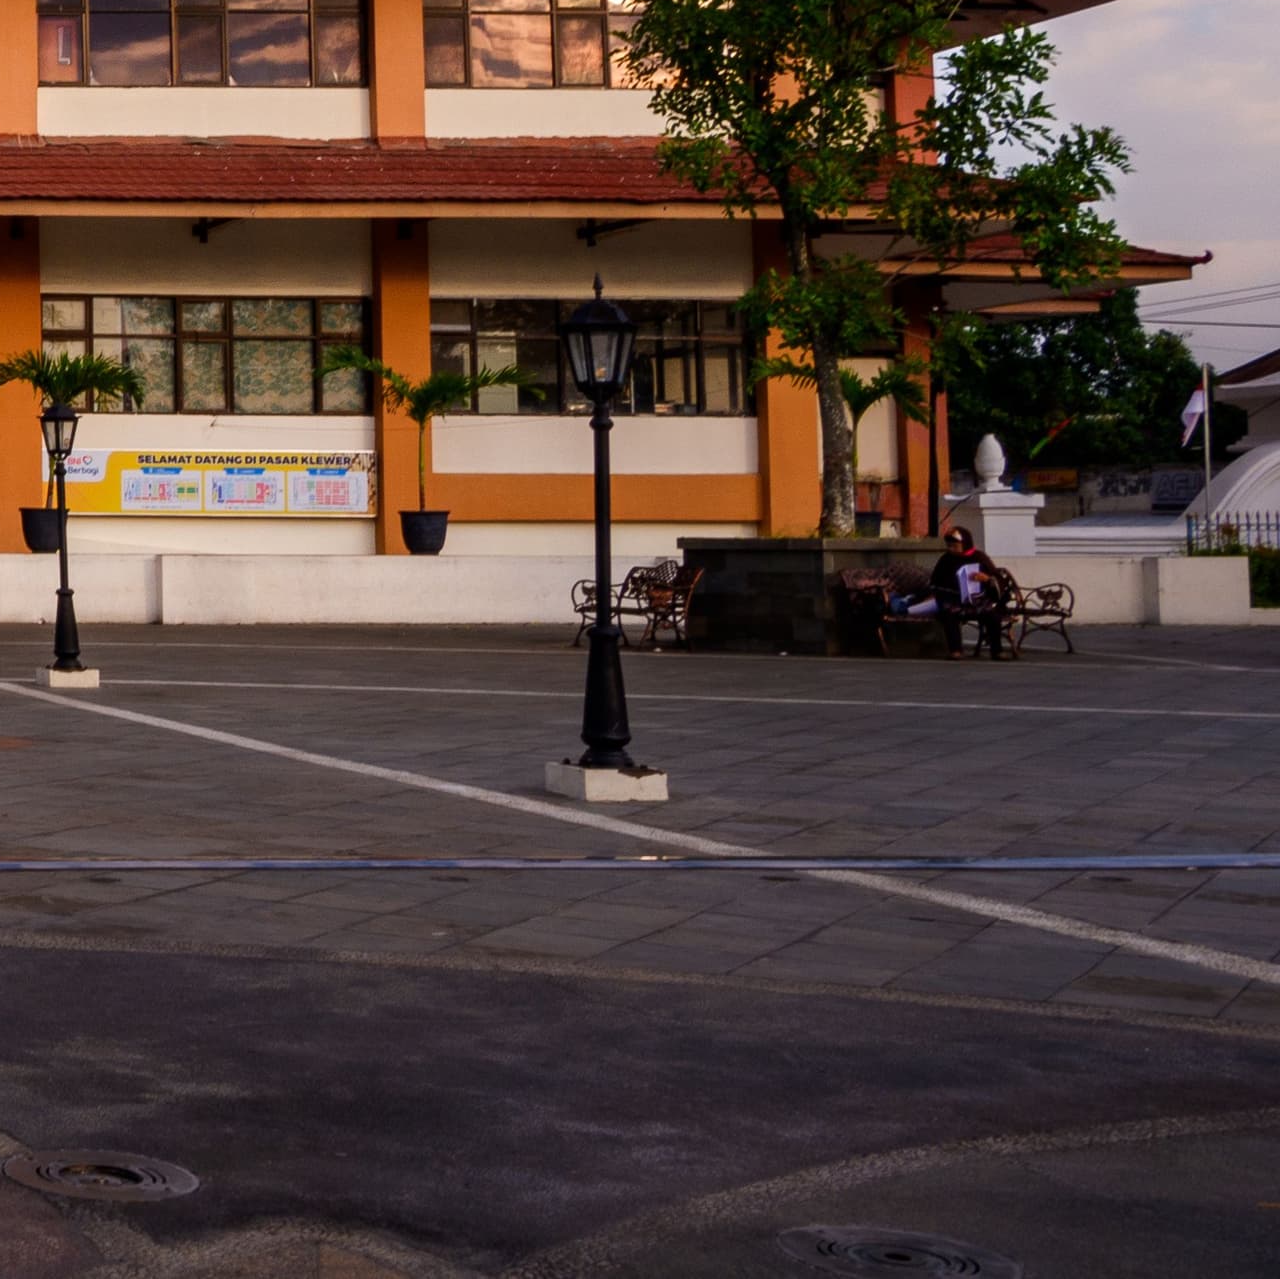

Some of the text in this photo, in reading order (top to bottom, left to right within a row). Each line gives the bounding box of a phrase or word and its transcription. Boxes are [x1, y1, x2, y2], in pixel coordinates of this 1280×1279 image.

[137, 454, 352, 466] SELAMAT DATANG DI PASAR KLEWER
[67, 466, 99, 476] Berbagi
